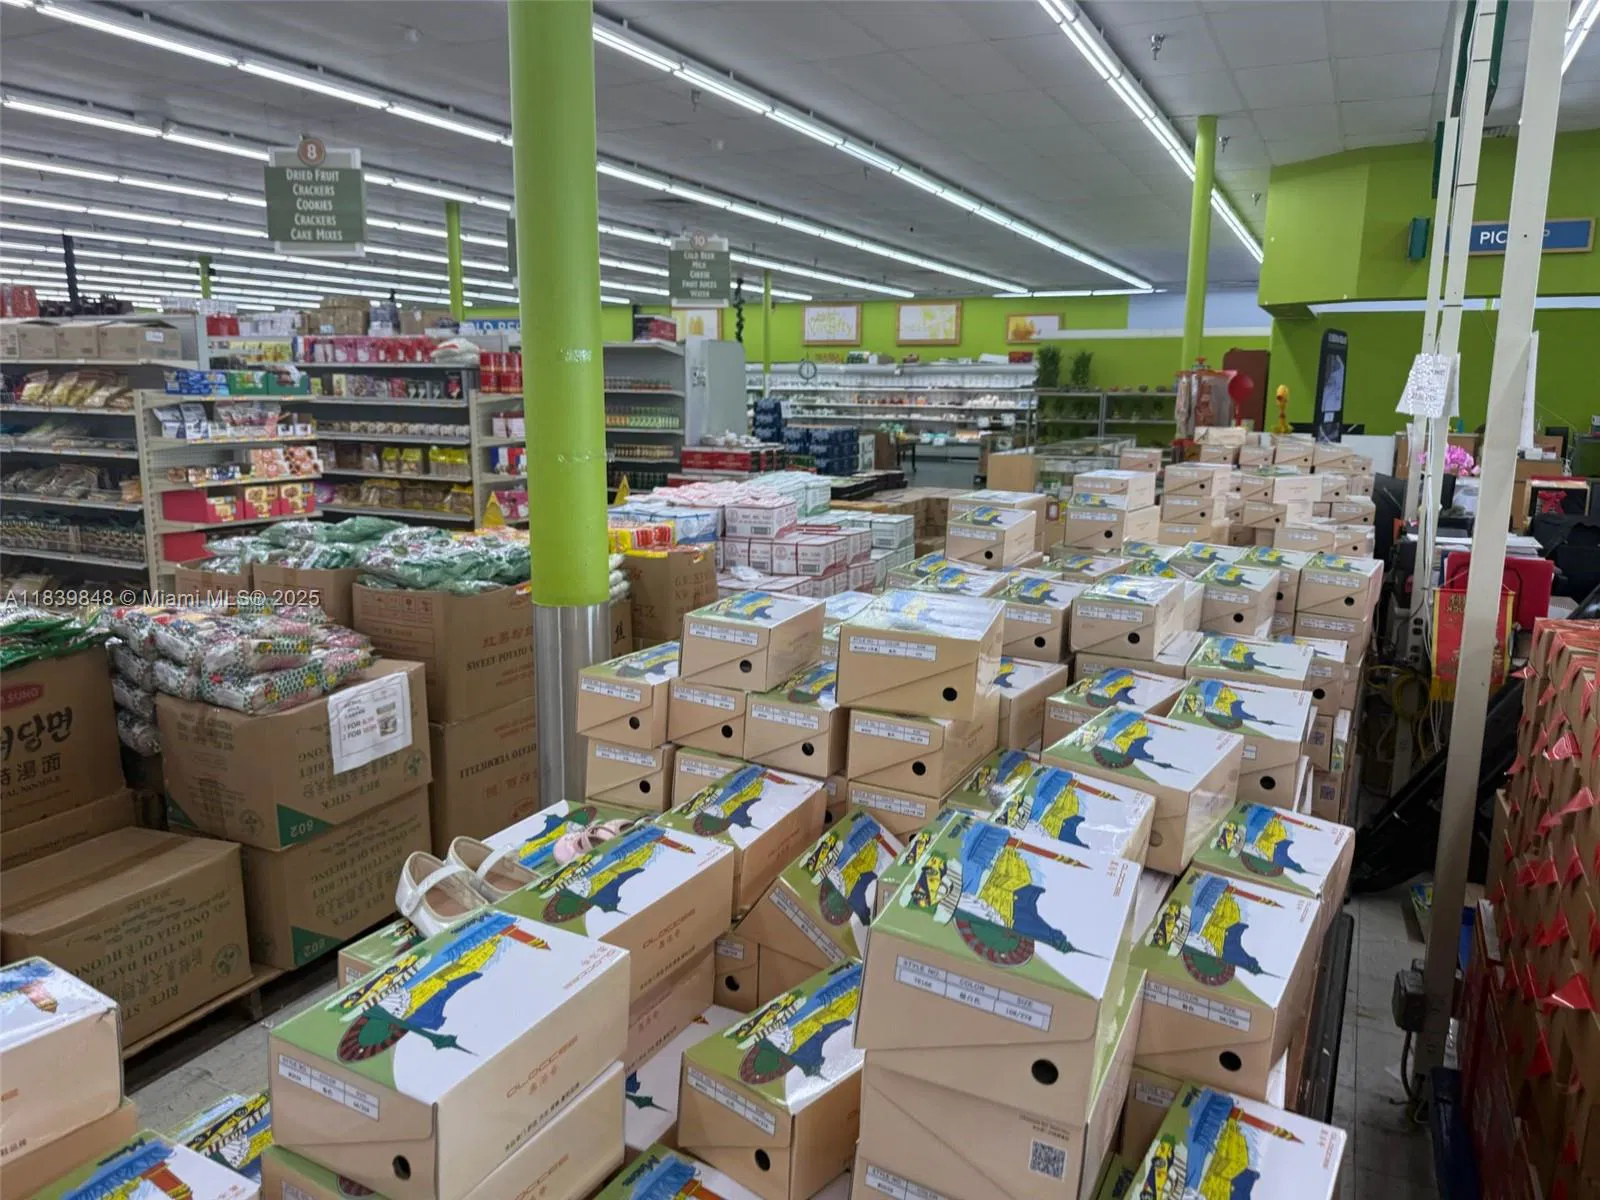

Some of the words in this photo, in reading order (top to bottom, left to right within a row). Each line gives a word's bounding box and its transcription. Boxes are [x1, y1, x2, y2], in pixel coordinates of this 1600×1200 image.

[307, 144, 317, 159] 8
[286, 168, 313, 181] DRIED
[315, 169, 340, 181] FRUIT
[292, 183, 335, 196] CRACKERS
[296, 198, 333, 211] COOKIES
[294, 212, 337, 226] CRACKERS
[290, 227, 312, 240] CAKE
[316, 228, 343, 241] MIXES
[694, 234, 705, 246] 10
[959, 979, 985, 993] COLOR
